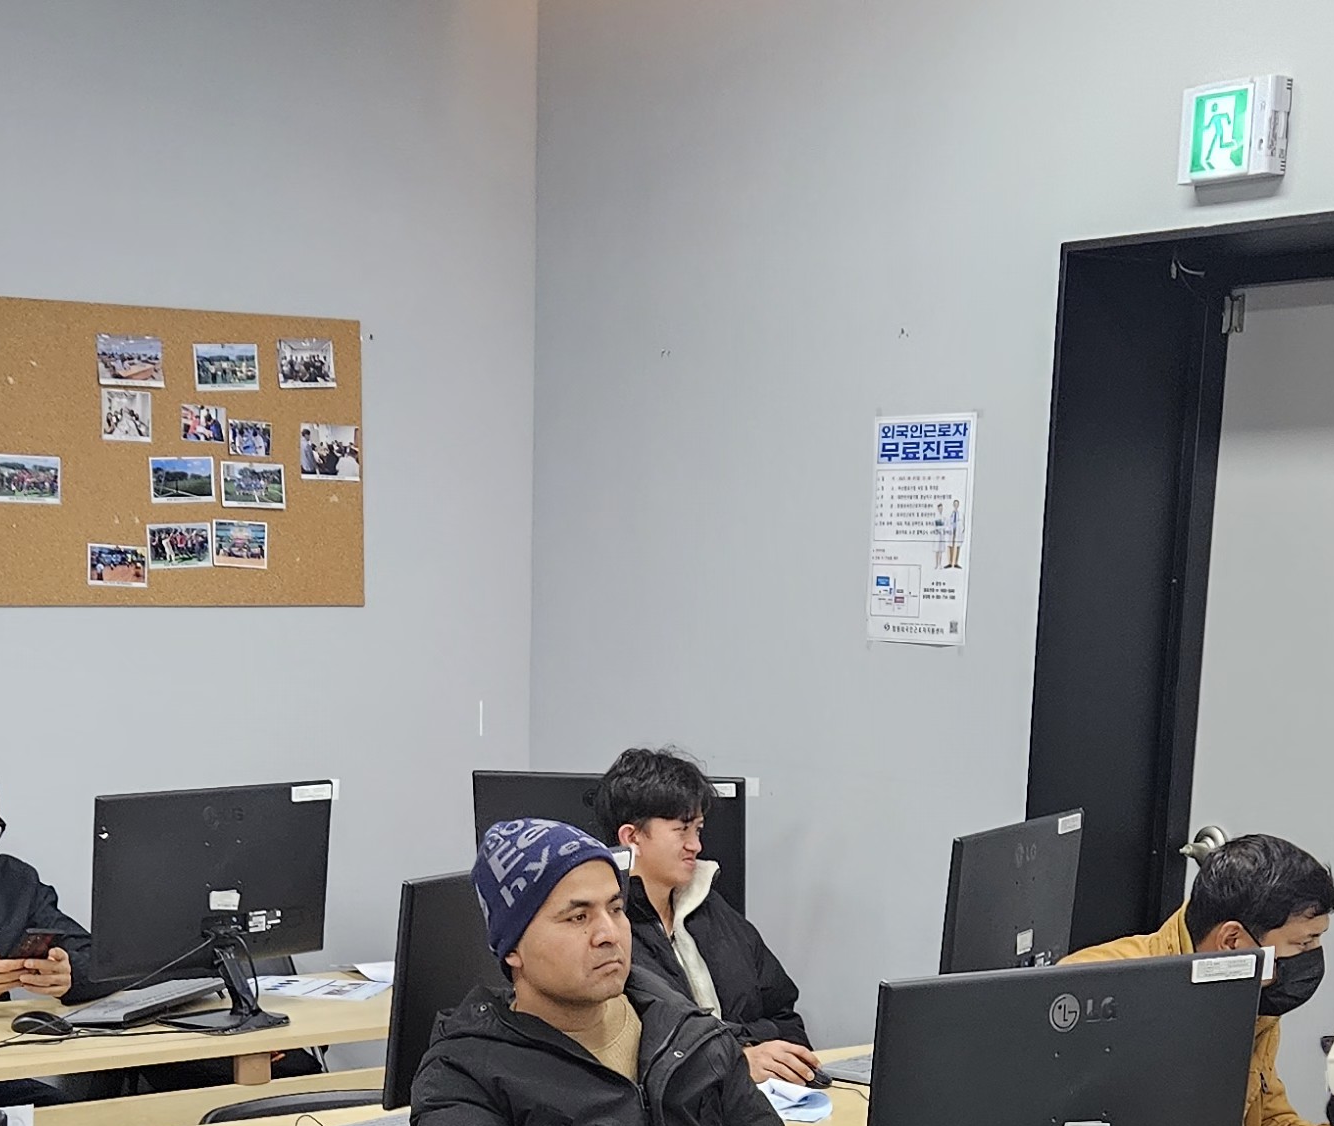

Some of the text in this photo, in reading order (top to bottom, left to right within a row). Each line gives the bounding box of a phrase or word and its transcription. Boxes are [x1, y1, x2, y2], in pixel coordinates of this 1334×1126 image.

[881, 422, 968, 439] 외국인근로자
[880, 440, 964, 462] 무료진료
[1085, 996, 1118, 1022] LG
